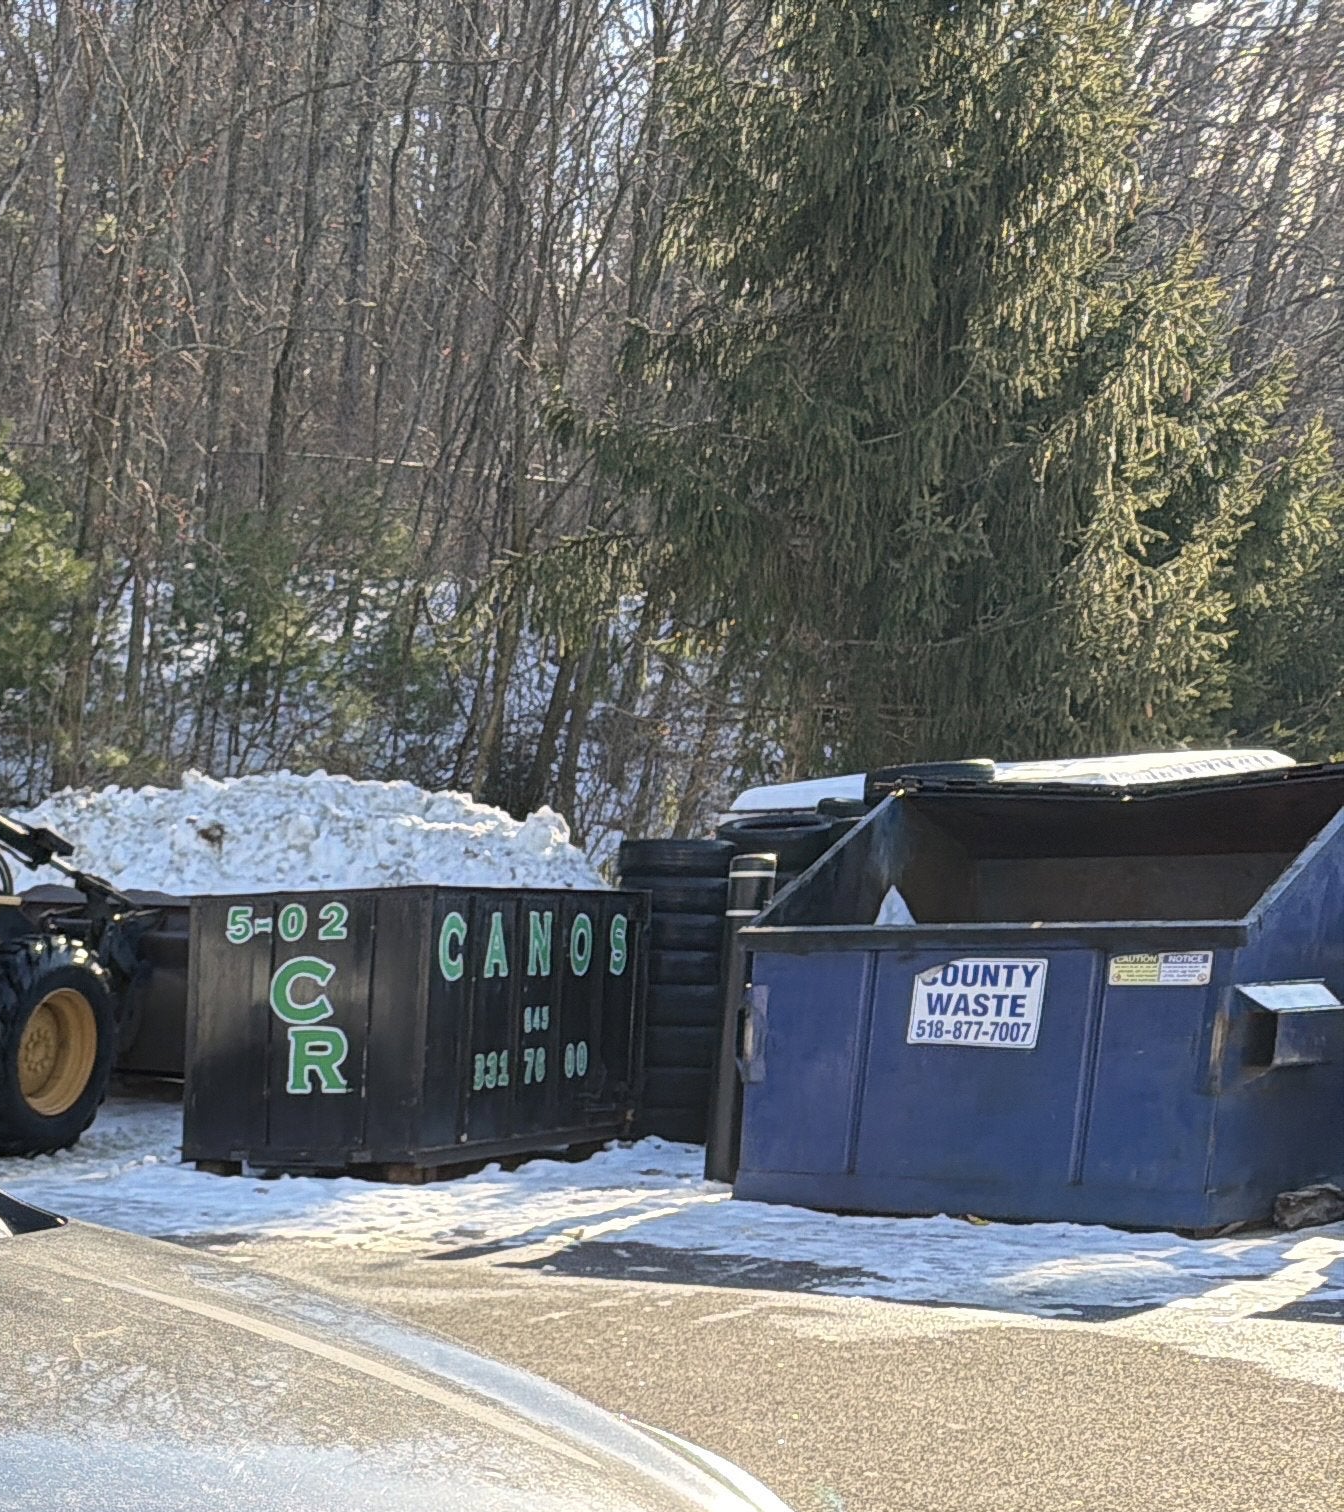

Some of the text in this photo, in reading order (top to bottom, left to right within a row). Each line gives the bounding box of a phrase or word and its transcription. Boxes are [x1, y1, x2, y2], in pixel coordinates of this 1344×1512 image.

[439, 911, 628, 982] CANOS
[1168, 954, 1203, 963] NOTICE
[926, 992, 1027, 1018] WASTE
[915, 1020, 1032, 1043] 518-877-7007
